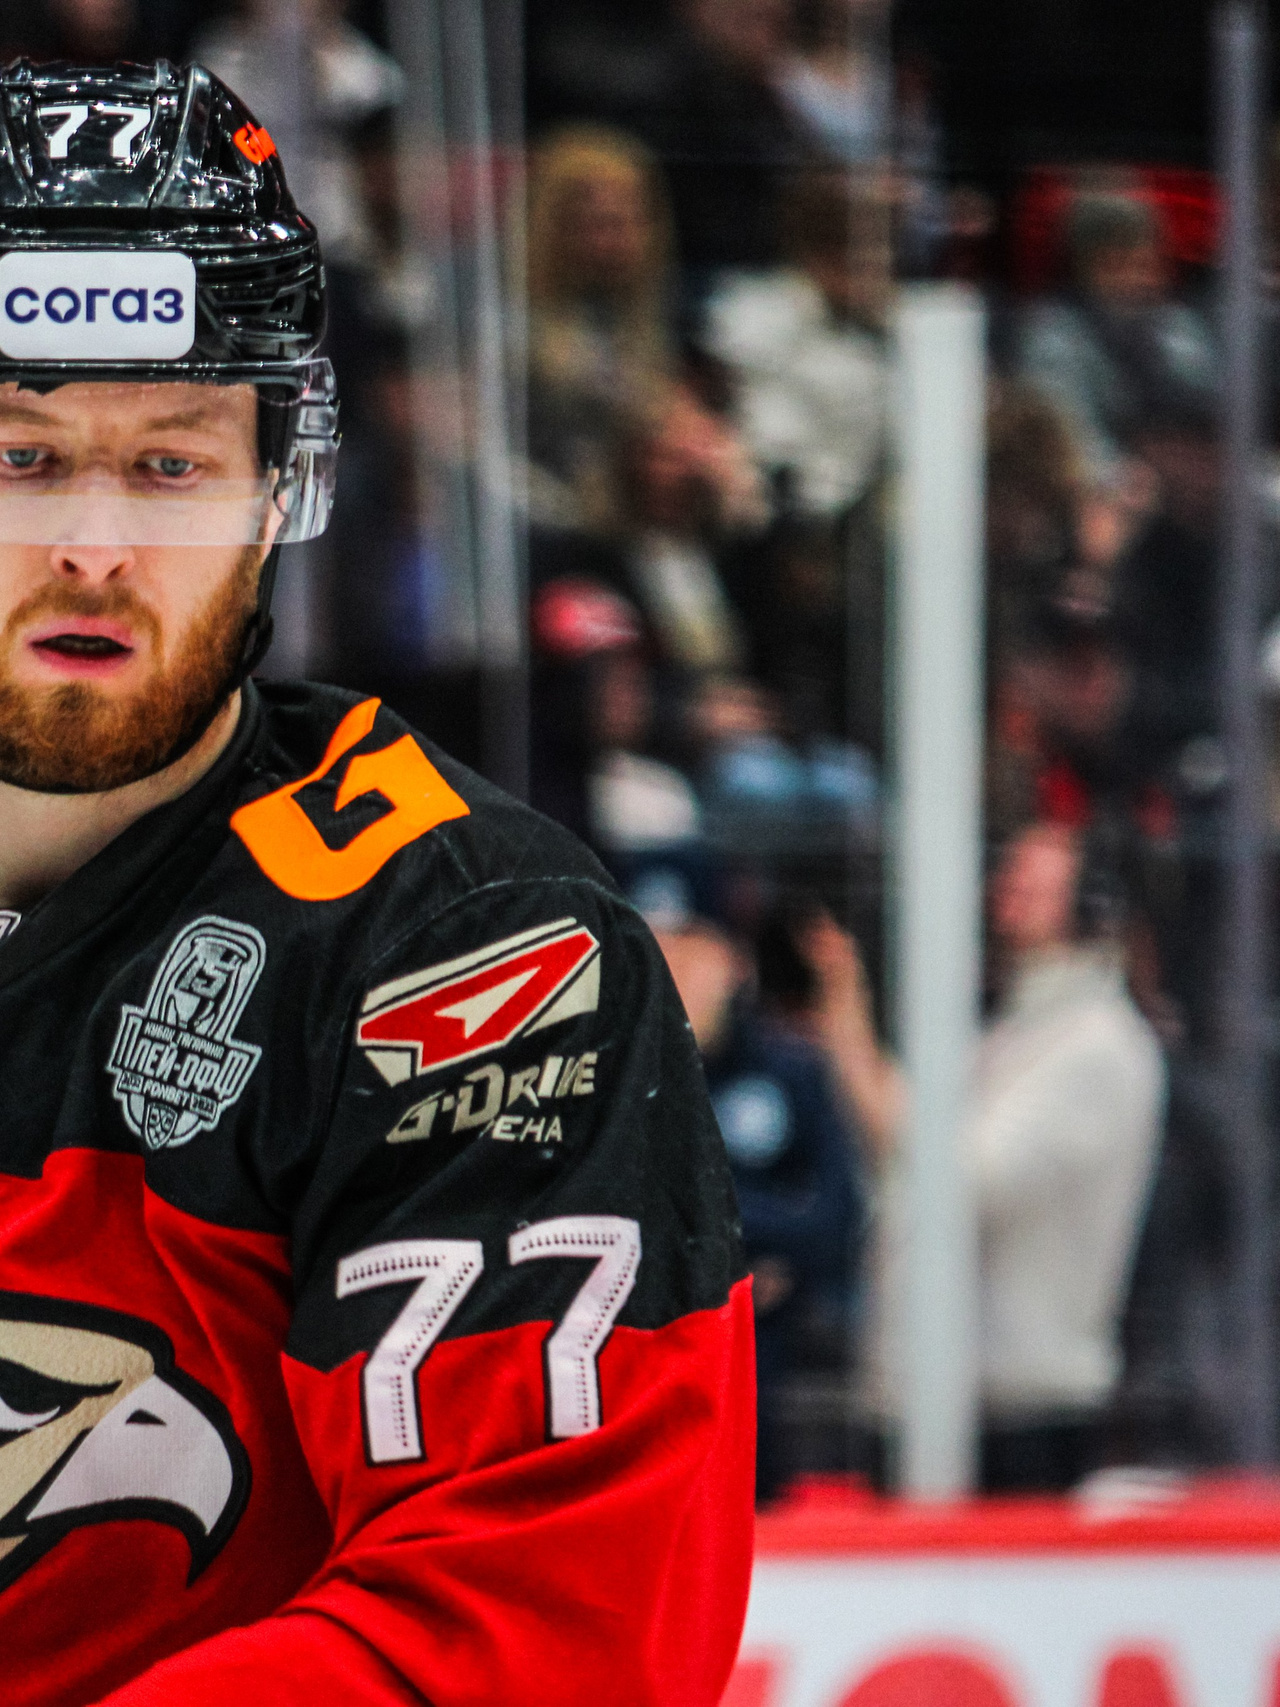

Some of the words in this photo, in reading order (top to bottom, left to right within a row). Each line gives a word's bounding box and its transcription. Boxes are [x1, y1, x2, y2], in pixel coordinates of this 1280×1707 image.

[40, 104, 151, 160] 77
[4, 286, 185, 324] согаз
[336, 1215, 642, 1463] 77
